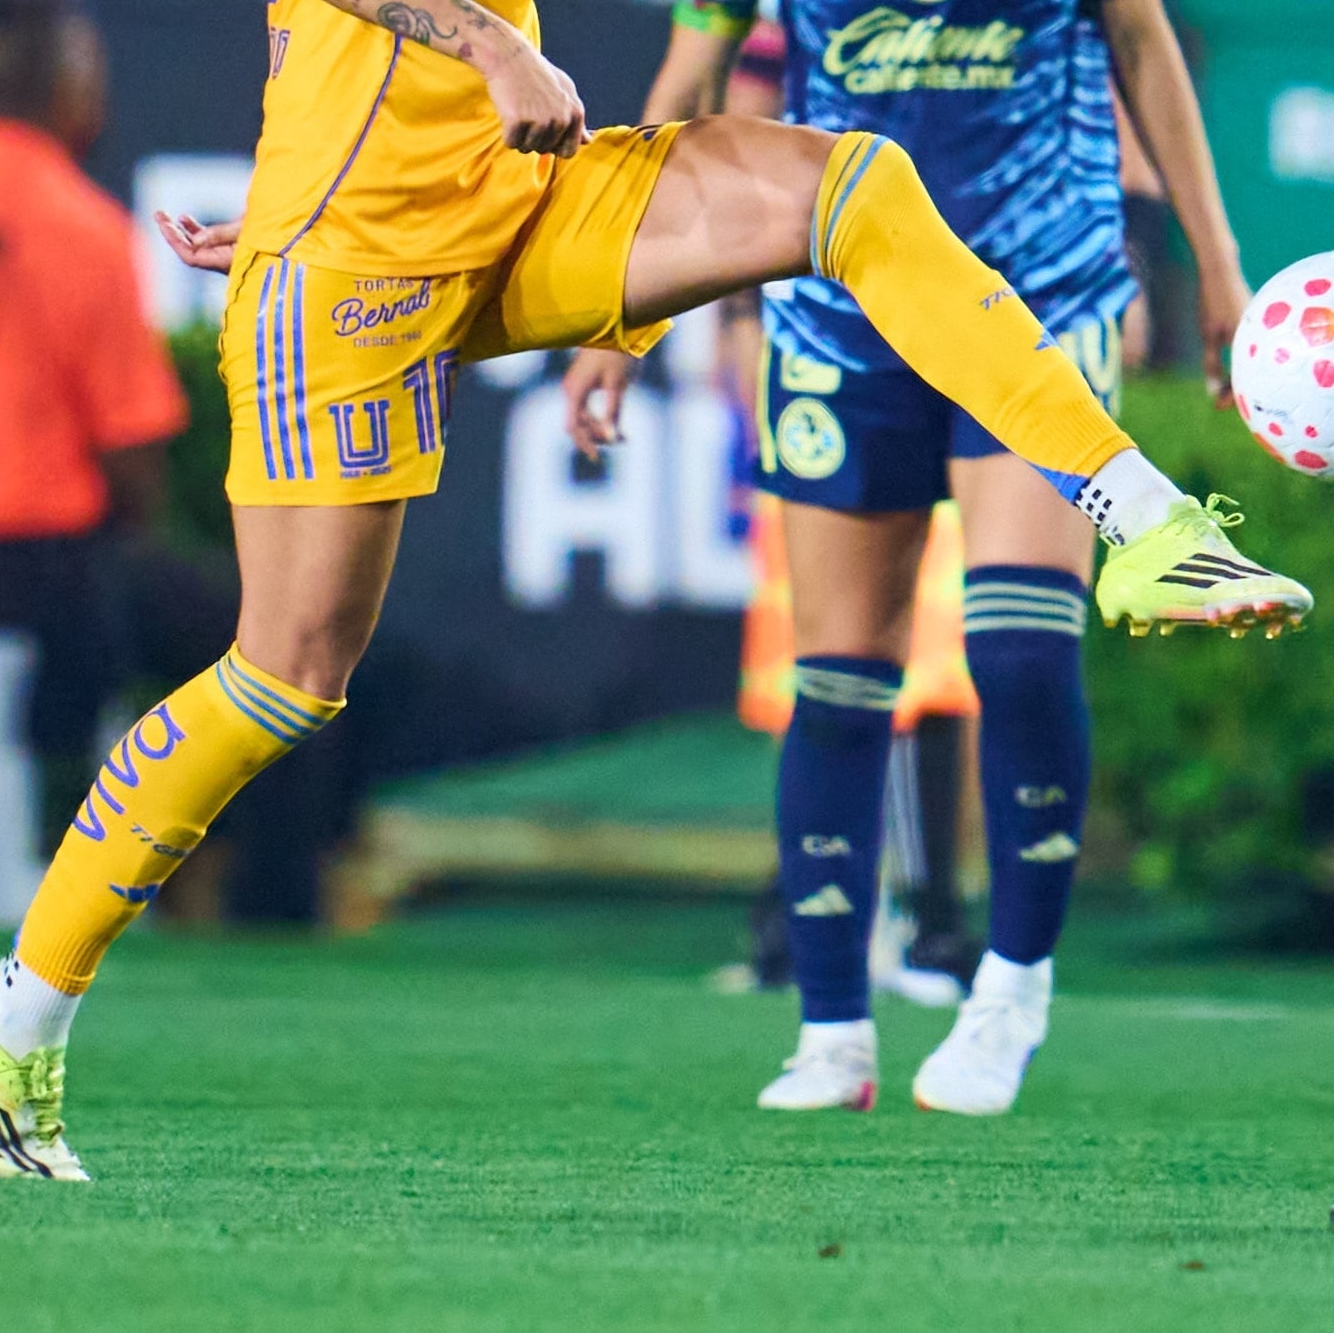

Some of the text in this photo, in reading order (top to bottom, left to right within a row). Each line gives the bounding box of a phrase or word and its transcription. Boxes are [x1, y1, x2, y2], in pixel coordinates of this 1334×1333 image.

[353, 277, 414, 293] TORTAS
[331, 276, 432, 337] Bernal
[353, 335, 397, 348] DESDE
[328, 399, 390, 468] U
